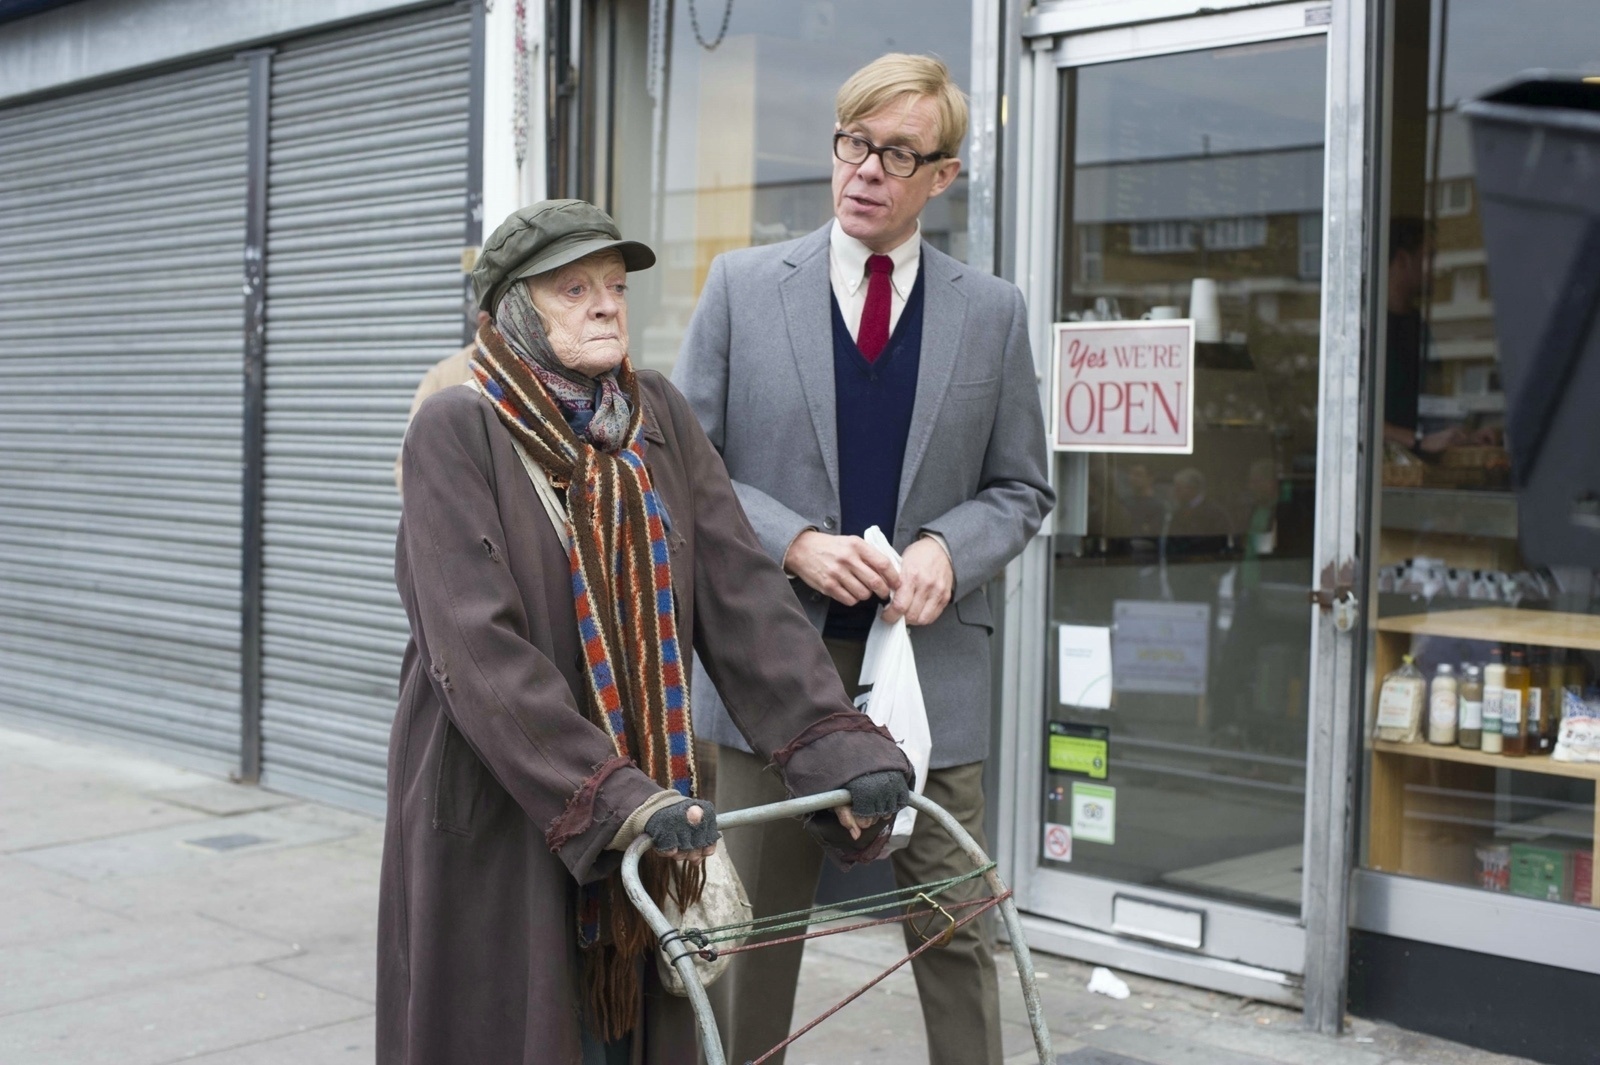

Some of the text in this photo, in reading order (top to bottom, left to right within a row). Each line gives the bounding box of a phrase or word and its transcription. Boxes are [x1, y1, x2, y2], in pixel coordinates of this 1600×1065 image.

[1068, 339, 1183, 379] Yes WE'RE
[1065, 380, 1183, 435] OPEN
